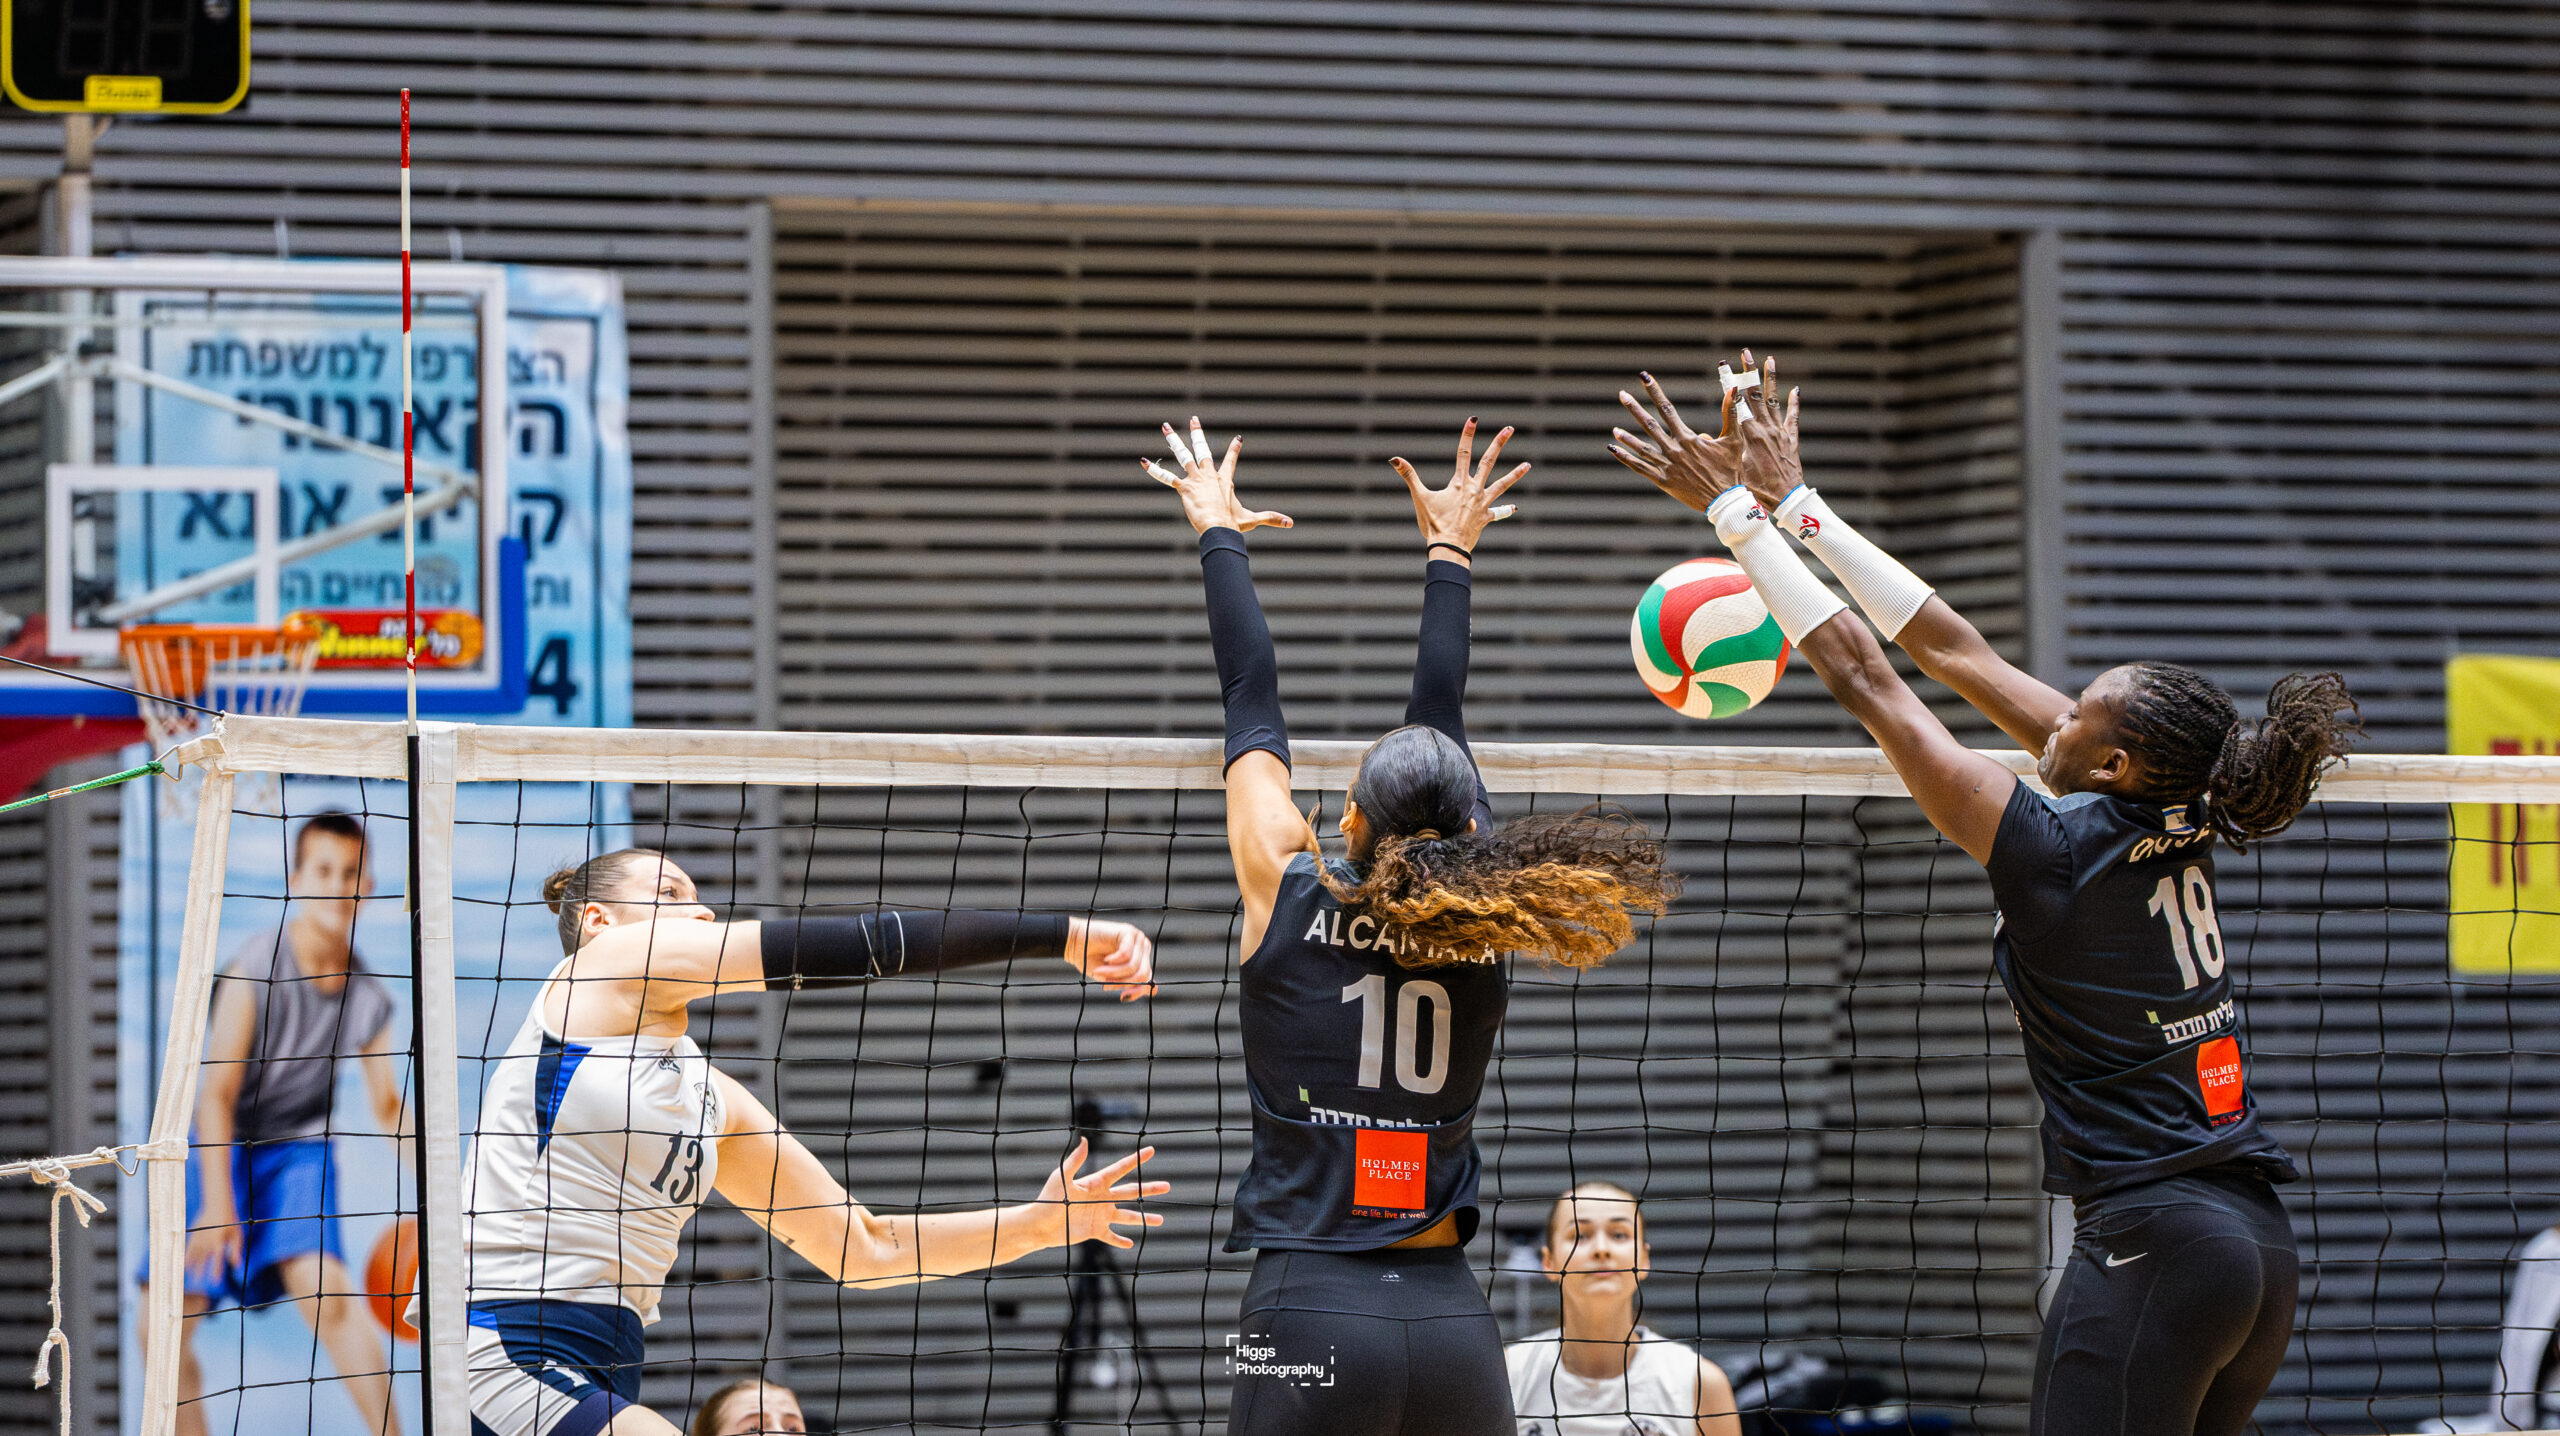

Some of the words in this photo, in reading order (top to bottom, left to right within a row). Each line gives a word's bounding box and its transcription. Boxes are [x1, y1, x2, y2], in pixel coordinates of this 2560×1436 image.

[186, 335, 388, 380] למשפחת
[1303, 909, 1497, 965] ALCANA
[2147, 865, 2225, 990] 18
[1341, 973, 1452, 1094] 10
[2161, 1014, 2208, 1045] חדרה
[2201, 1063, 2239, 1079] HOLMES
[2207, 1074, 2236, 1088] PLACE
[650, 1130, 704, 1204] 13
[1361, 1158, 1420, 1171] HOLMES
[1368, 1169, 1412, 1181] PLACE
[1352, 1209, 1368, 1217] one
[1384, 1209, 1398, 1219] live
